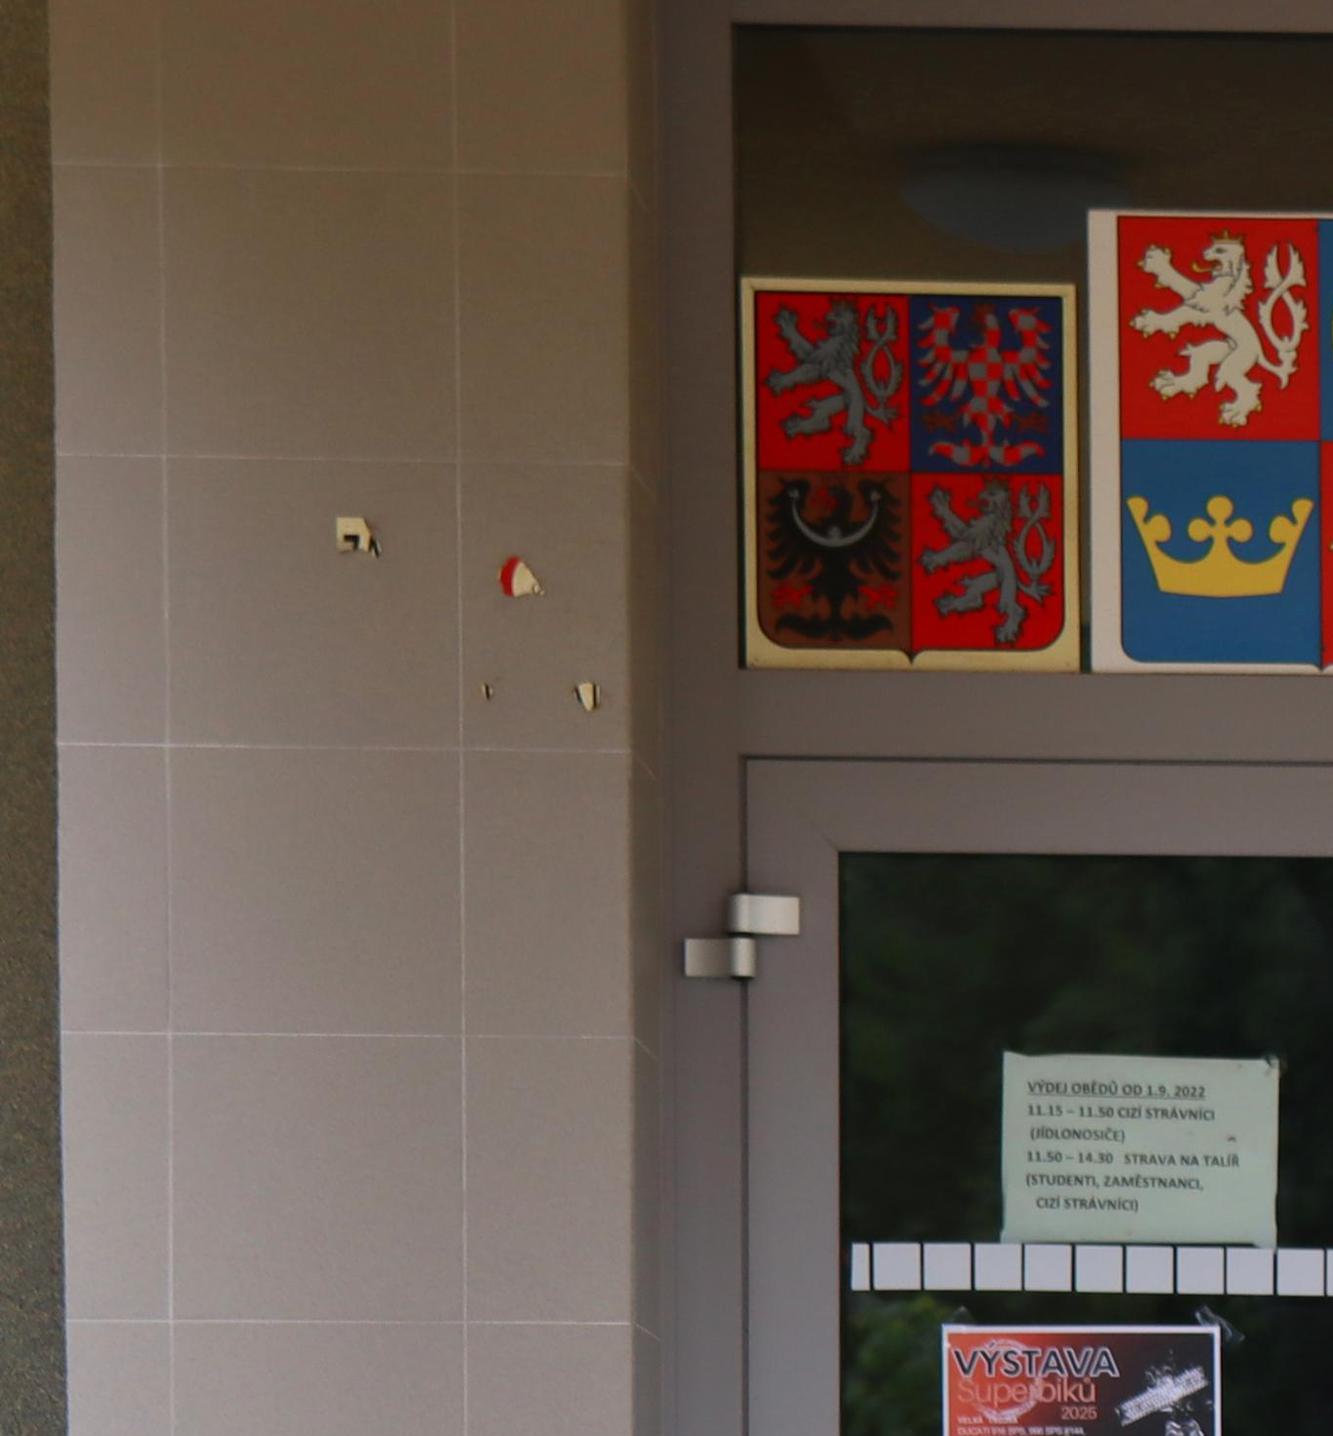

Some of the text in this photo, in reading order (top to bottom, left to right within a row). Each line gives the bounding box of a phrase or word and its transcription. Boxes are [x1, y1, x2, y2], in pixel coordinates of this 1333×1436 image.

[1028, 1080, 1206, 1098] VÝDEJ OBĚDŮ OD 1.9. 2022
[1028, 1106, 1063, 1117] 11.15
[1080, 1106, 1114, 1118] 11.50
[1118, 1106, 1142, 1119] CIZÍ
[1145, 1106, 1215, 1121] STRÁVNÍCI
[1030, 1126, 1125, 1143] (JÍDLONOSIČE)
[1027, 1152, 1062, 1163] 11.50
[1078, 1152, 1113, 1164] 14.30
[1124, 1154, 1176, 1166] STRAVA
[1180, 1155, 1199, 1166] NA
[1203, 1154, 1239, 1167] TALÍŘ
[1026, 1174, 1204, 1191] (STUDENTI, ZAMĚSTNANCI,
[1036, 1197, 1139, 1212] CIZÍ STRÁVNÍCI)
[954, 1340, 1120, 1378] VÝSTAVA
[958, 1377, 1096, 1407] Superbiků
